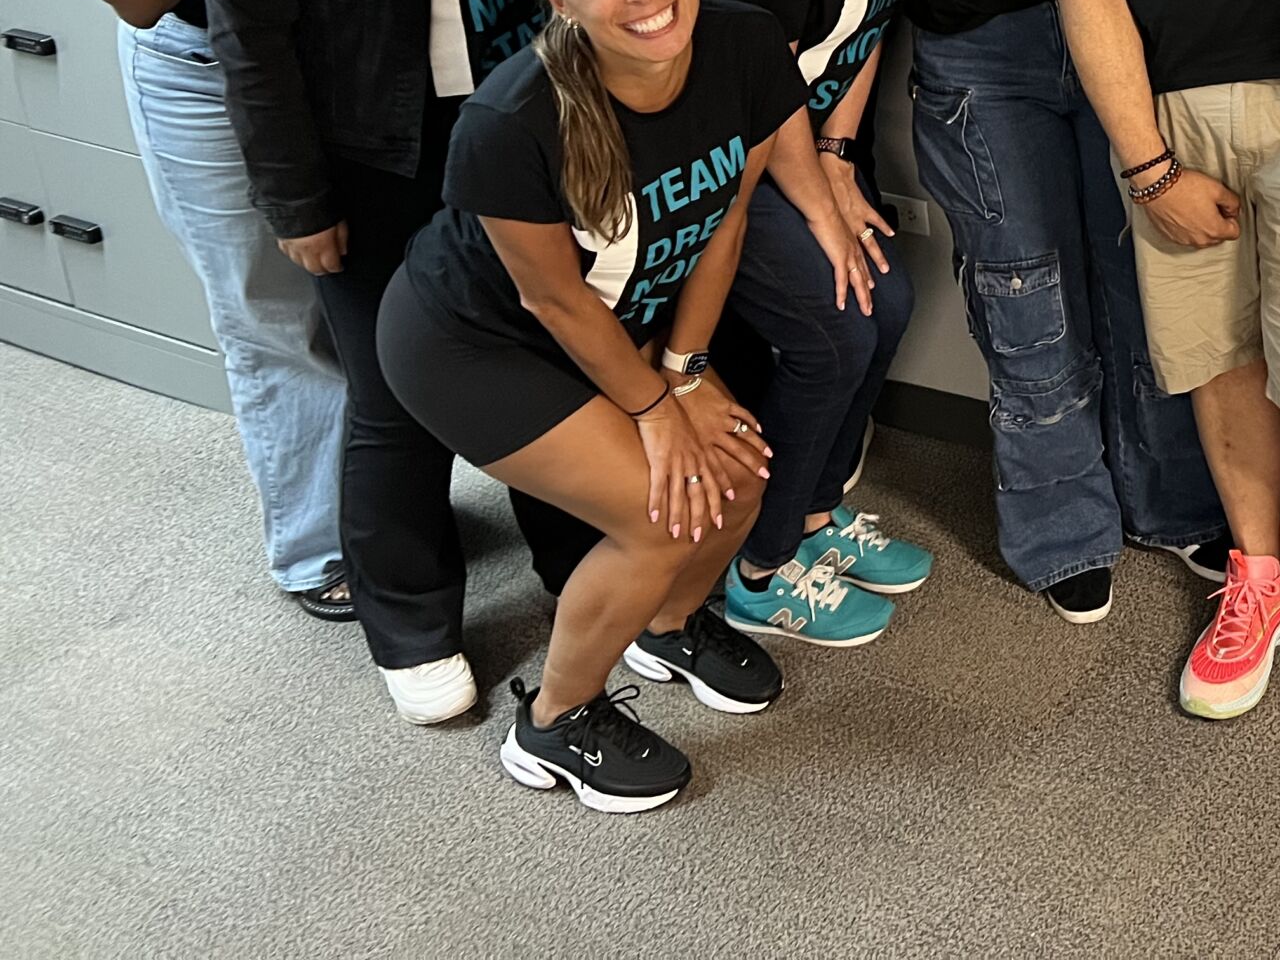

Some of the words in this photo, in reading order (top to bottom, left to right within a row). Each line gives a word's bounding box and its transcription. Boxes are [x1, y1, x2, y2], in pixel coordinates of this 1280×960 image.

[642, 136, 746, 223] TEAM
[643, 194, 738, 270] DRE
[767, 607, 807, 632] N
